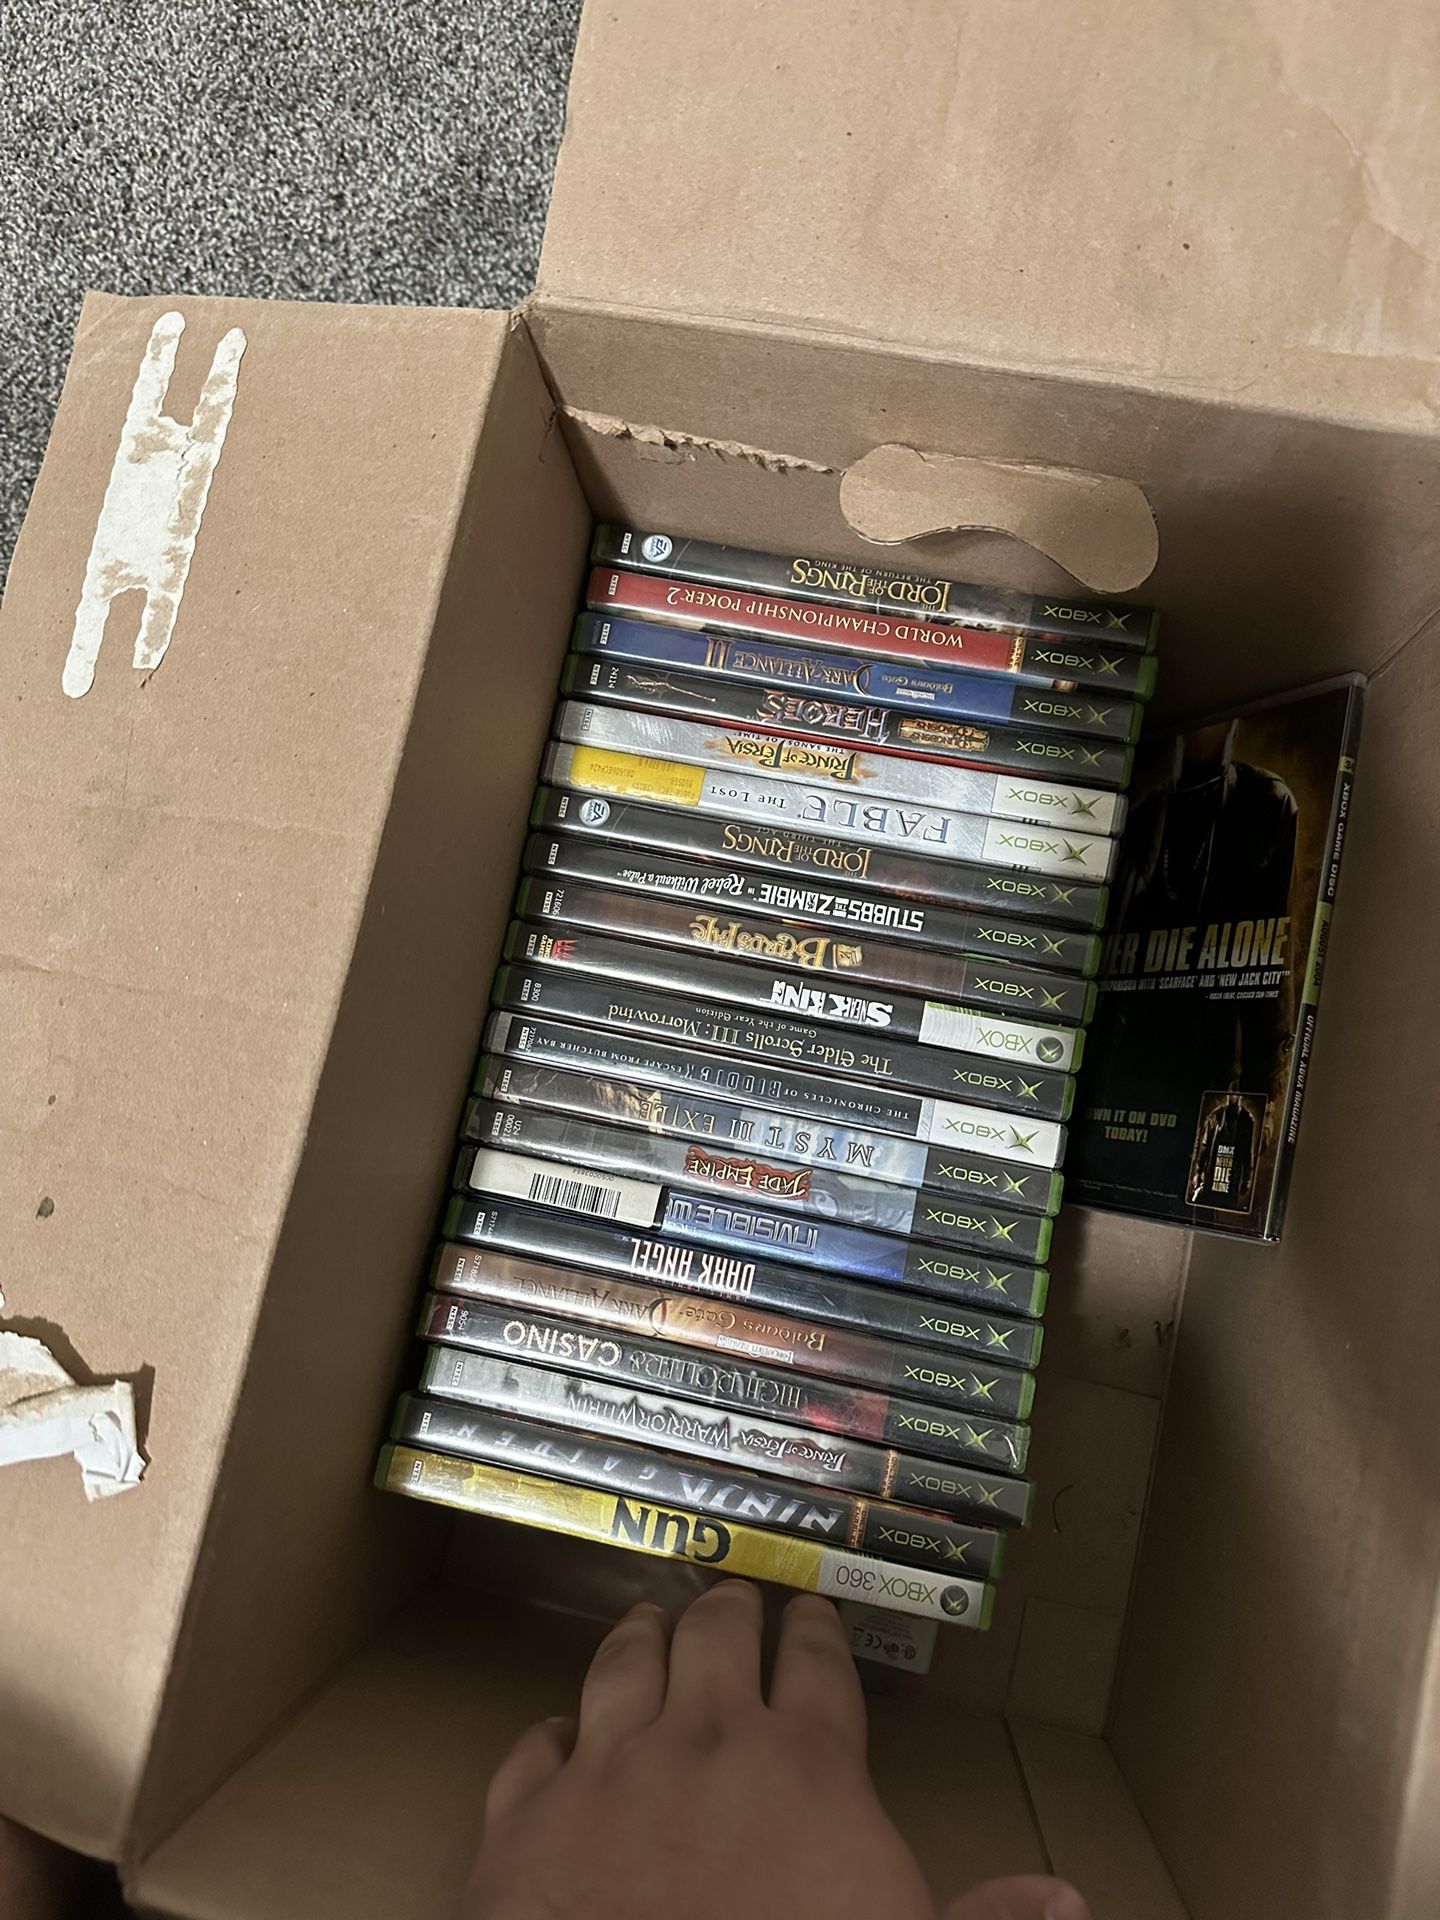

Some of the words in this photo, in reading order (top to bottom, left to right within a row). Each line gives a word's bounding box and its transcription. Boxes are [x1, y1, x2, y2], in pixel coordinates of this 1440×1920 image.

[653, 538, 667, 558] EA
[789, 557, 868, 597] RINGS
[866, 577, 887, 587] THE
[665, 586, 680, 604] 2
[682, 588, 741, 611] POKER
[868, 586, 883, 595] OF
[885, 573, 951, 612] LORD
[745, 599, 890, 636] CHAMPIONSHIP
[1042, 604, 1101, 624] XBOX
[894, 624, 964, 648] WORLD
[700, 635, 735, 671] II
[732, 646, 822, 684] ALLIANCE
[1033, 649, 1093, 669] XBOX
[817, 655, 875, 695] DARK
[753, 687, 891, 746] HEROES
[1022, 699, 1081, 718] XBOX
[721, 731, 784, 768] PERSIA
[787, 740, 820, 750] SANDS
[823, 746, 844, 754] THE
[1015, 739, 1074, 760] XBOX
[796, 743, 855, 780] PRINCE
[709, 786, 749, 801] LOST
[1007, 787, 1068, 807] XBOX
[1339, 782, 1351, 818] XBOX
[590, 801, 605, 822] EA
[802, 794, 951, 843] FABLE
[720, 823, 795, 863] RINGS
[793, 844, 812, 854] THE
[998, 834, 1058, 854] XBOX
[1332, 822, 1344, 860] GAME
[796, 853, 809, 861] OF
[811, 839, 871, 879] LORD
[621, 868, 646, 883] Pulse
[647, 872, 654, 881] a
[653, 871, 698, 893] Without
[700, 868, 745, 898] Rebel
[985, 877, 1046, 897] XBOX
[1327, 864, 1338, 897] DISC
[758, 882, 835, 915] ZOMBIE
[846, 898, 924, 931] STUBBS
[976, 927, 1037, 948] XBOX
[1144, 927, 1197, 973] DIE
[1197, 917, 1291, 969] ALONE
[531, 982, 541, 1001] 8300
[974, 977, 1034, 998] XBOX
[1238, 972, 1261, 986] JACK
[762, 975, 826, 1015] KING
[606, 1003, 700, 1036] Morrowind
[694, 1006, 731, 1021] Edition
[733, 1014, 755, 1025] Year
[825, 993, 892, 1028] SNEAK
[703, 1022, 741, 1045] III:
[758, 1019, 773, 1029] the
[775, 1022, 786, 1032] of
[789, 1024, 816, 1037] Game
[1301, 1015, 1315, 1057] OFFICIAL
[536, 1036, 555, 1046] BAY
[559, 1041, 606, 1056] BUTCHER
[744, 1029, 804, 1057] Scrolls
[976, 1027, 1032, 1053] XBOX
[610, 1051, 639, 1064] FROM
[642, 1058, 681, 1072] ESCAPE
[806, 1042, 855, 1067] Elder
[859, 1053, 894, 1075] The
[682, 1063, 781, 1097] RIDDICK
[783, 1088, 797, 1096] OF
[951, 1068, 1012, 1091] XBOX
[802, 1091, 880, 1113] CHRONICLES
[886, 1108, 909, 1119] THE
[638, 1098, 715, 1133] EXILE
[1113, 1110, 1125, 1123] IT
[1128, 1111, 1145, 1125] ON
[1149, 1112, 1177, 1128] DVD
[727, 1118, 753, 1141] III
[944, 1117, 1005, 1141] XBOX
[1105, 1126, 1148, 1143] TODAY!
[764, 1125, 873, 1167] MYST
[685, 1155, 754, 1190] EMPIRE
[755, 1162, 810, 1201] JADE
[936, 1162, 998, 1186] XBOX
[1213, 1167, 1232, 1182] DIE
[694, 1203, 818, 1249] INVISIBLE
[925, 1208, 986, 1232] XBOX
[626, 1238, 693, 1280] ANGEL
[917, 1257, 980, 1283] XBOX
[698, 1253, 755, 1294] DARK
[509, 1275, 608, 1315] ALLIANCE
[608, 1290, 669, 1337] DARK
[918, 1315, 980, 1340] XBOX
[501, 1317, 622, 1368] CASINO
[902, 1364, 966, 1390] XBOX
[745, 1375, 801, 1409] HIGH
[897, 1414, 961, 1439] XBOX
[736, 1428, 787, 1459] PERSIA
[797, 1443, 846, 1472] PRINCE
[909, 1472, 972, 1498] XBOX
[674, 1471, 844, 1534] NINJA
[609, 1495, 733, 1565] GUN
[877, 1525, 940, 1552] XBOX
[834, 1564, 876, 1590] 360
[877, 1573, 937, 1604] XBOX
